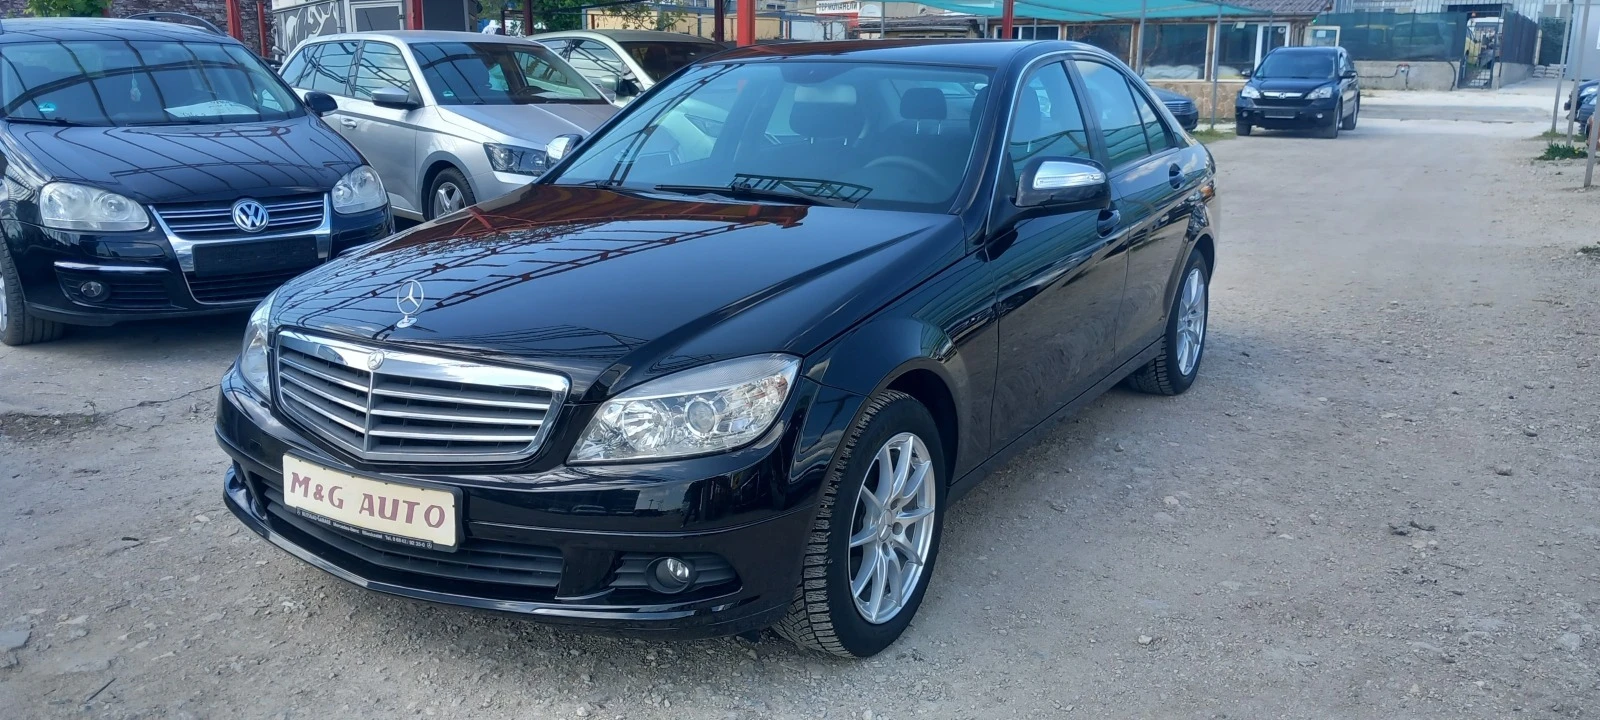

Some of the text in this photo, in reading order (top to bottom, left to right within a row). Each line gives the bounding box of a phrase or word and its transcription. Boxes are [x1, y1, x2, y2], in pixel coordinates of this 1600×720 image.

[234, 200, 267, 231] VW
[290, 471, 446, 529] M&G AUTO
